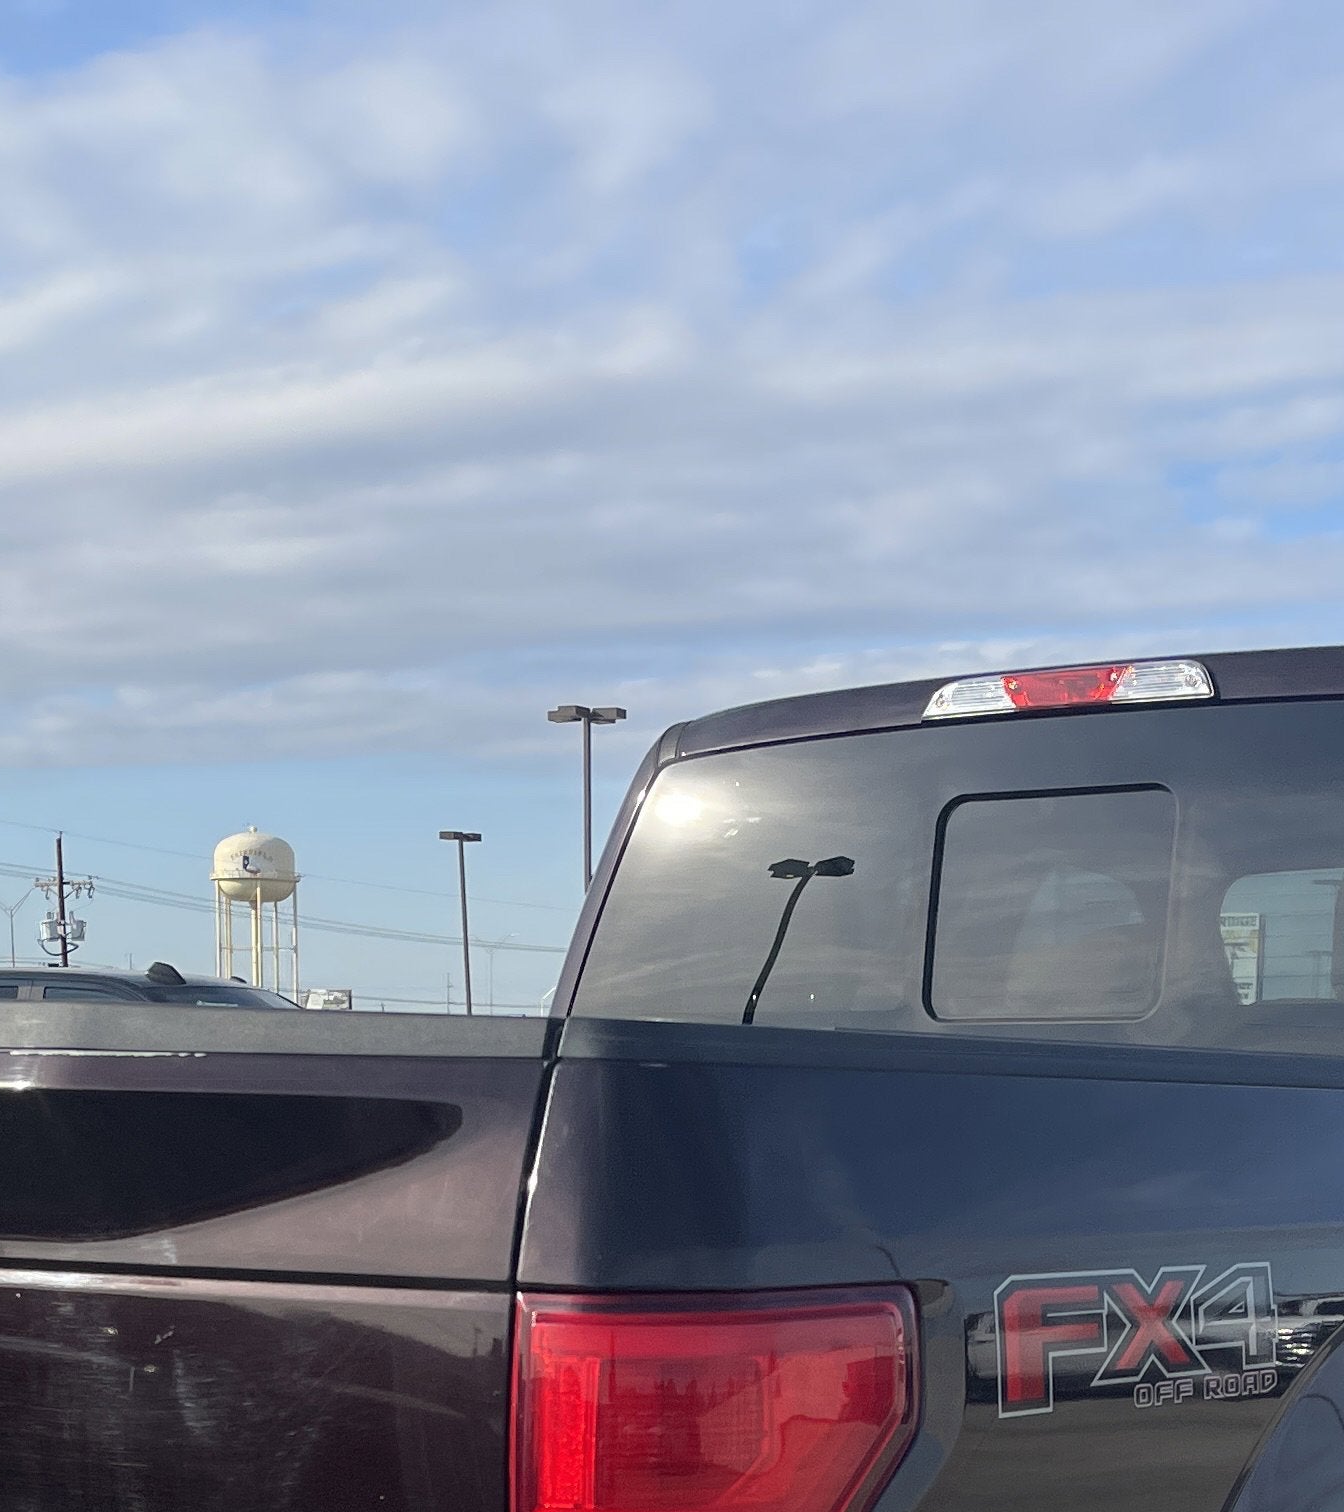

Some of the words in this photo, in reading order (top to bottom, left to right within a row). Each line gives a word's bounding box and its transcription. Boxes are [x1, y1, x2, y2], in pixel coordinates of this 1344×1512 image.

[993, 1261, 1279, 1418] FX4
[1133, 1379, 1194, 1408] OFF
[1203, 1369, 1278, 1400] ROAD
